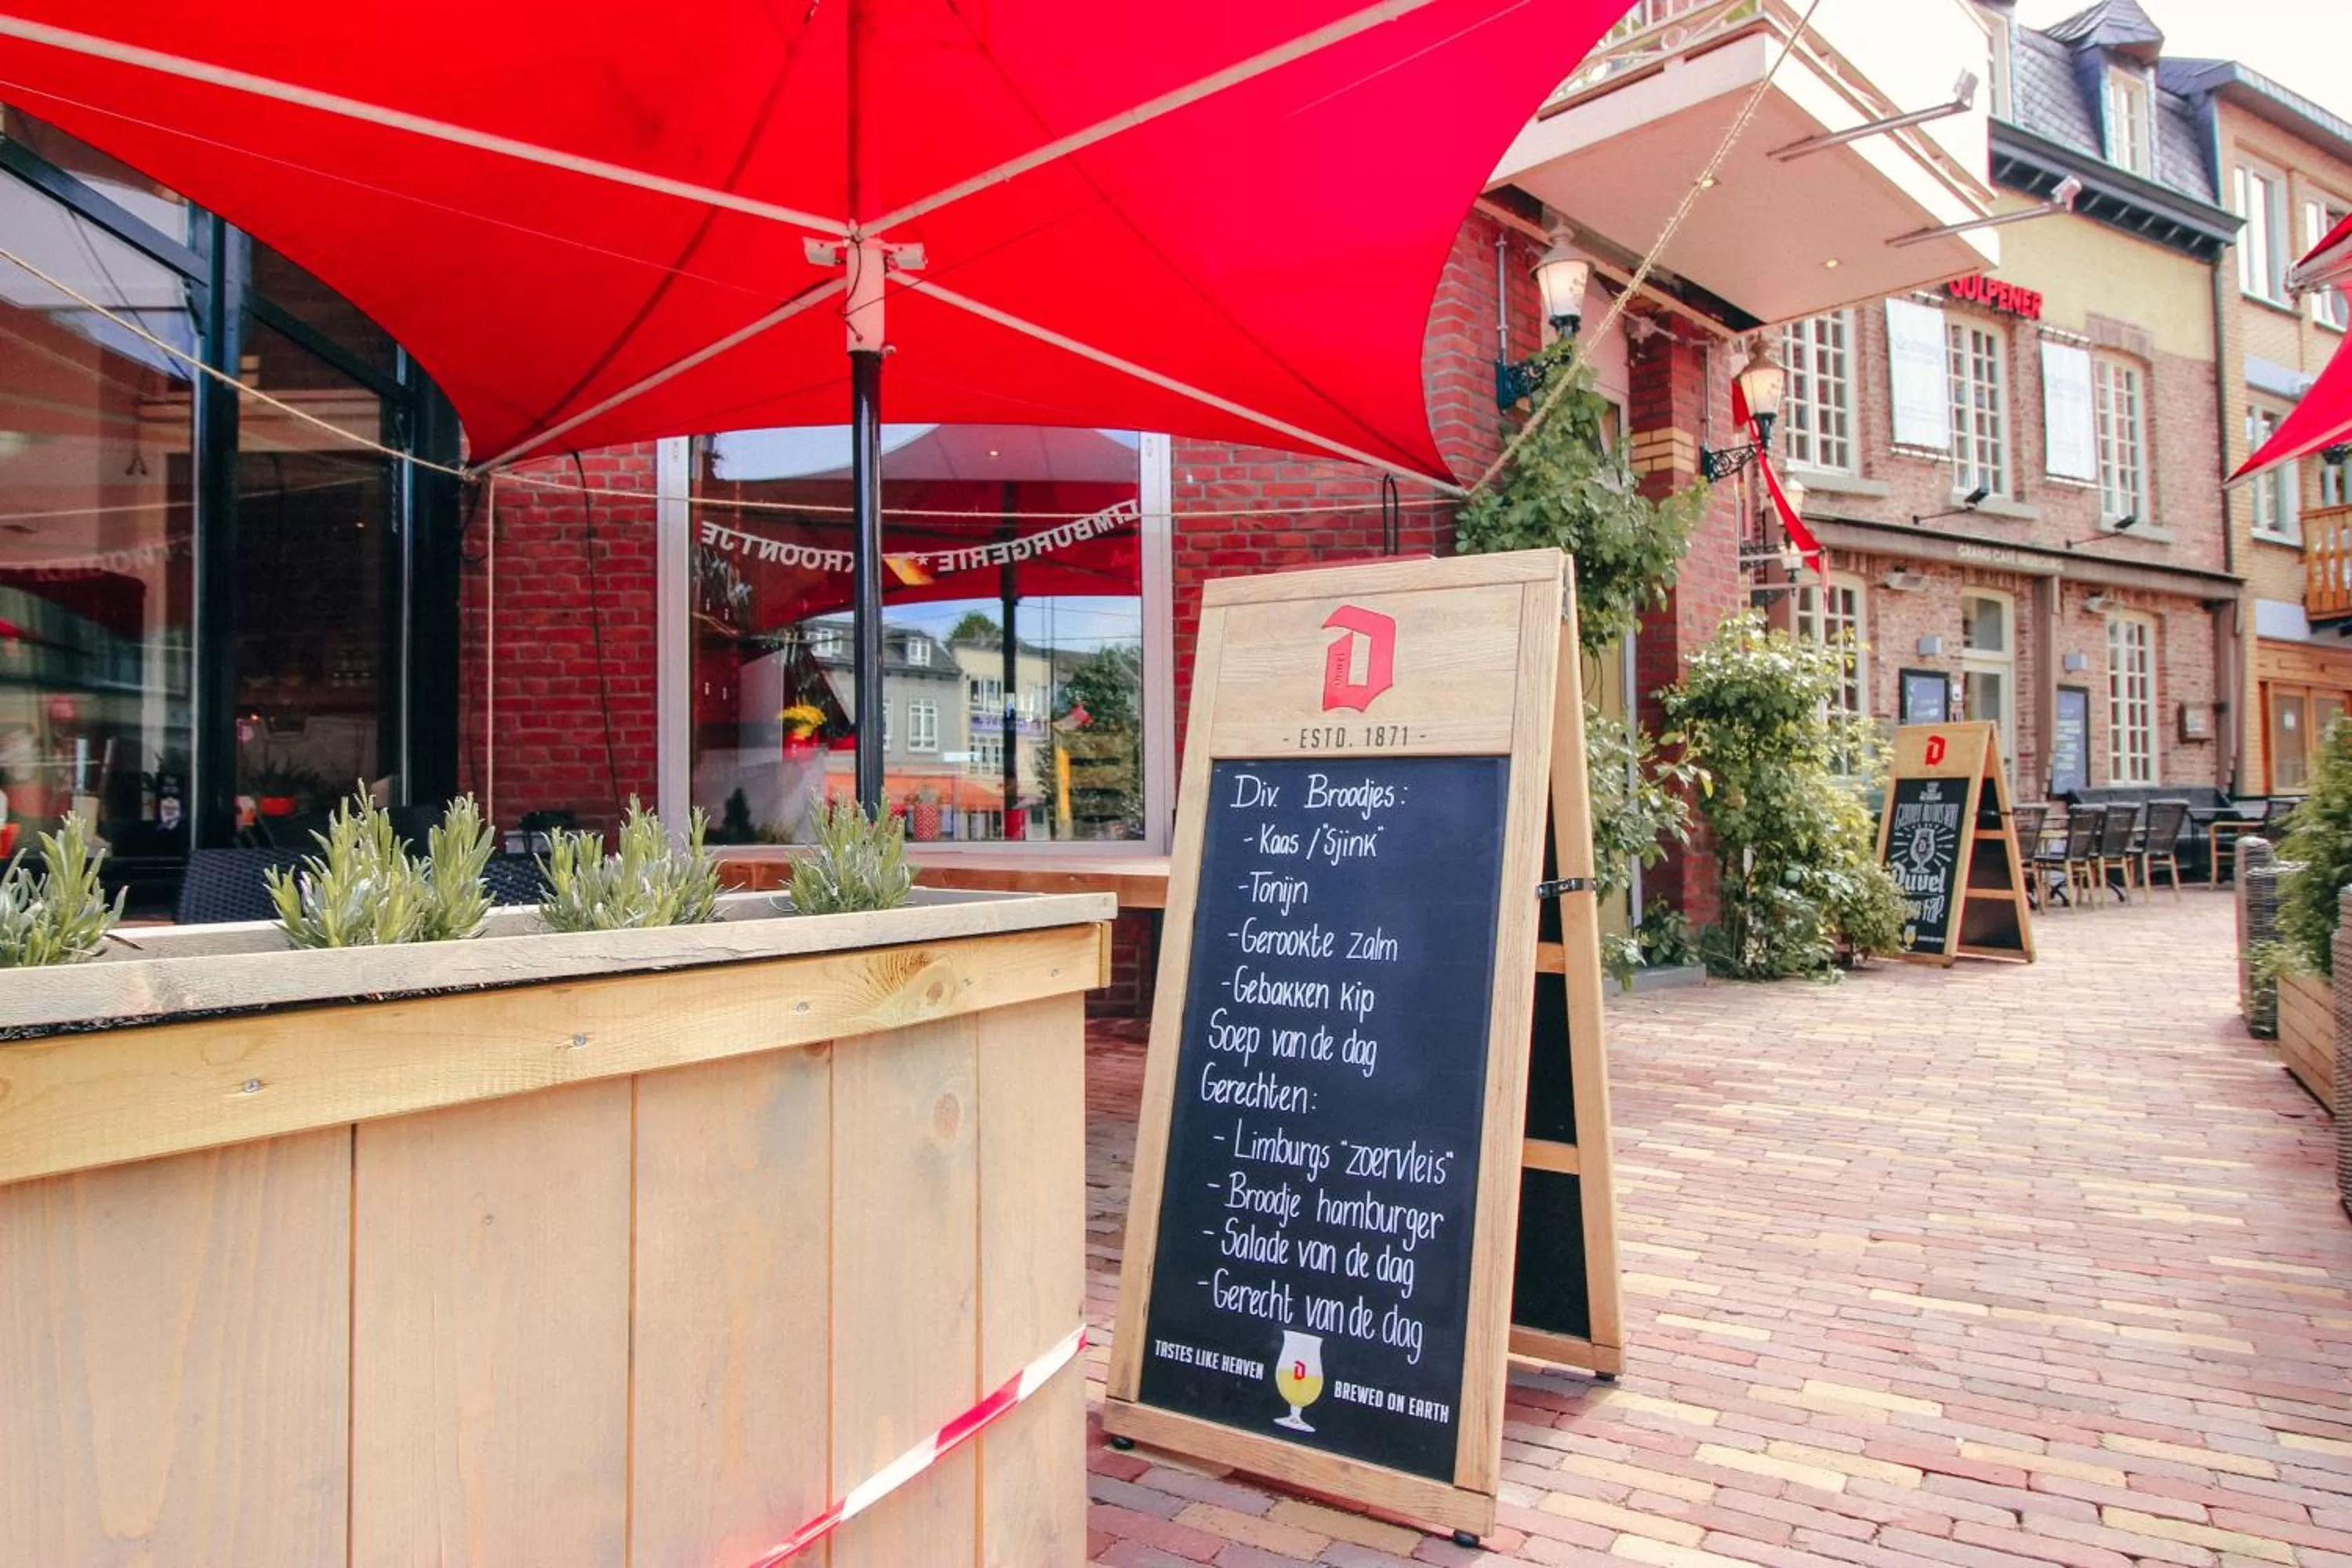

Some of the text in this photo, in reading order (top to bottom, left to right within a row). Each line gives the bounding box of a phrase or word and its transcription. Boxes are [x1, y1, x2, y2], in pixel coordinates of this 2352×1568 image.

[1300, 727, 1353, 749] ESTD.
[1367, 725, 1409, 747] 1871
[1259, 822, 1299, 855] Kaas
[1208, 1007, 1377, 1078] Soep van de dag
[1234, 1118, 1330, 1182] Limburgs
[1224, 1171, 1301, 1229] Broodje
[1316, 1188, 1445, 1252] hamburger
[1221, 1217, 1290, 1265] Salade
[1298, 1240, 1336, 1274] van
[1345, 1242, 1370, 1279] de
[1376, 1244, 1415, 1300] dag
[1154, 1339, 1265, 1381] TASTES LIKE HEAVEN
[1306, 1295, 1345, 1334] van
[1348, 1295, 1375, 1341] de
[1381, 1304, 1424, 1365] dag
[1334, 1380, 1450, 1425] BREWED ON EARTH
